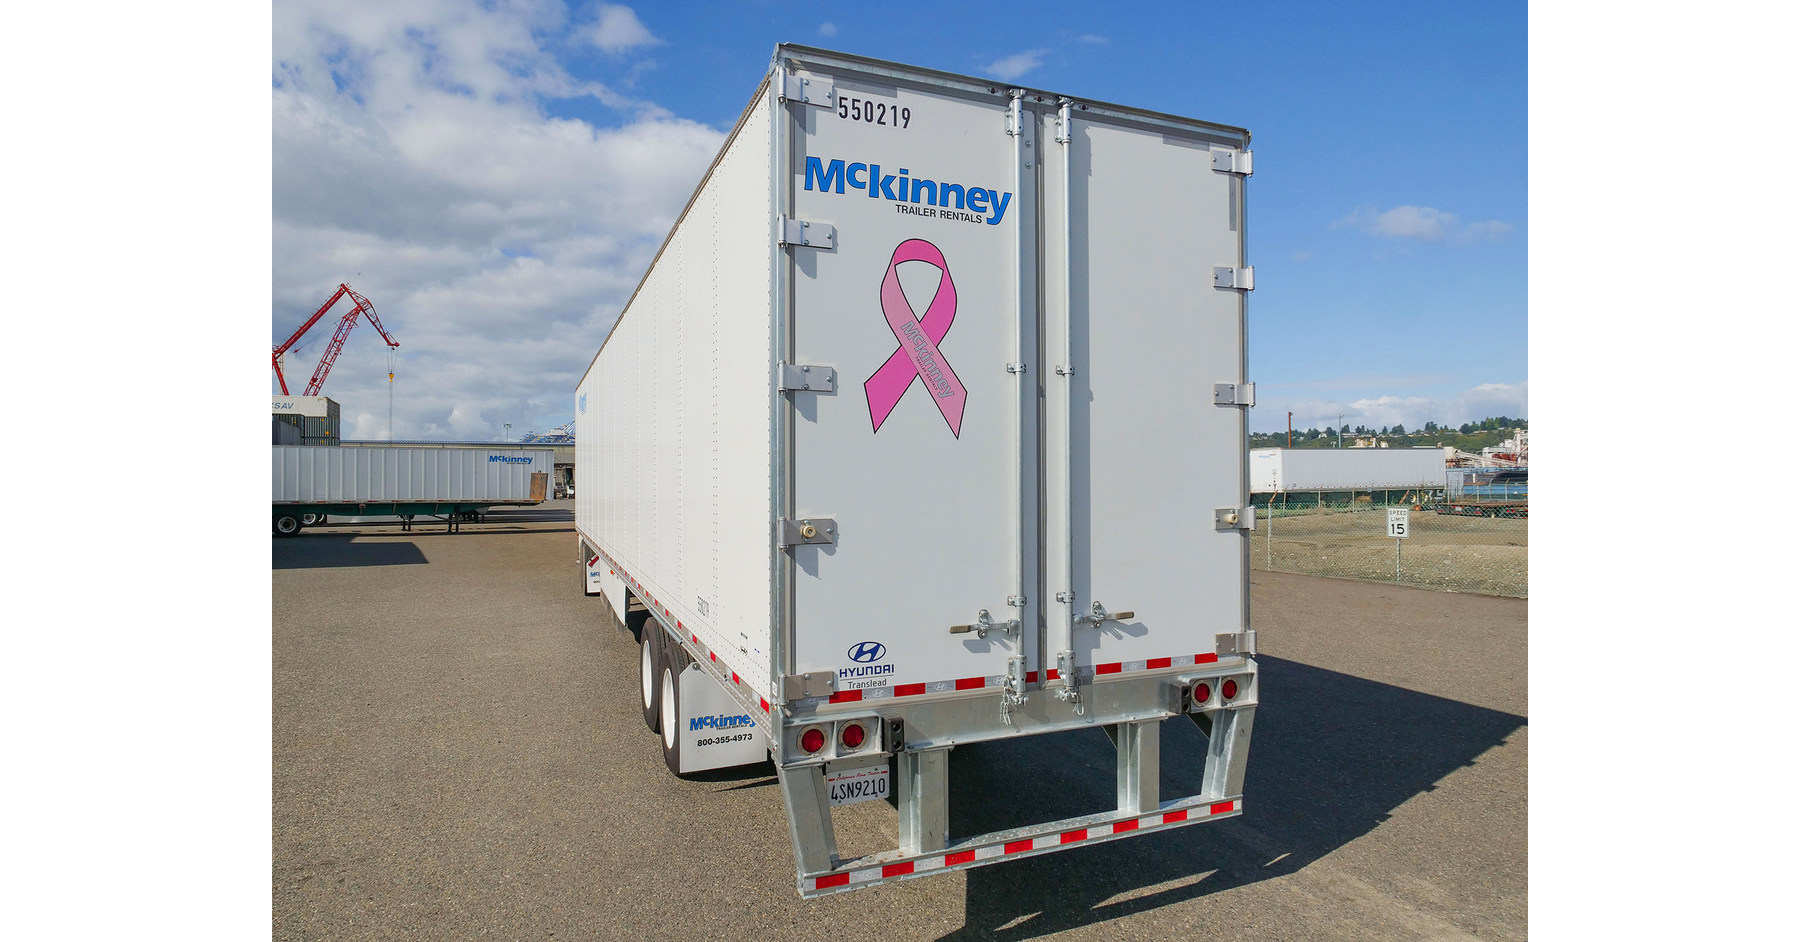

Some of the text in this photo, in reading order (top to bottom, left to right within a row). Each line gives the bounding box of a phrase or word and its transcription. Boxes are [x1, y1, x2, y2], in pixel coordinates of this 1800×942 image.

[838, 96, 911, 129] 550219
[895, 204, 982, 224] TRAILER RENTALS
[1391, 523, 1405, 534] 15
[839, 664, 895, 678] HYUNDAI
[847, 678, 887, 690] Translead
[697, 733, 753, 747] 800-355-4973
[831, 777, 886, 801] 4SN9210
